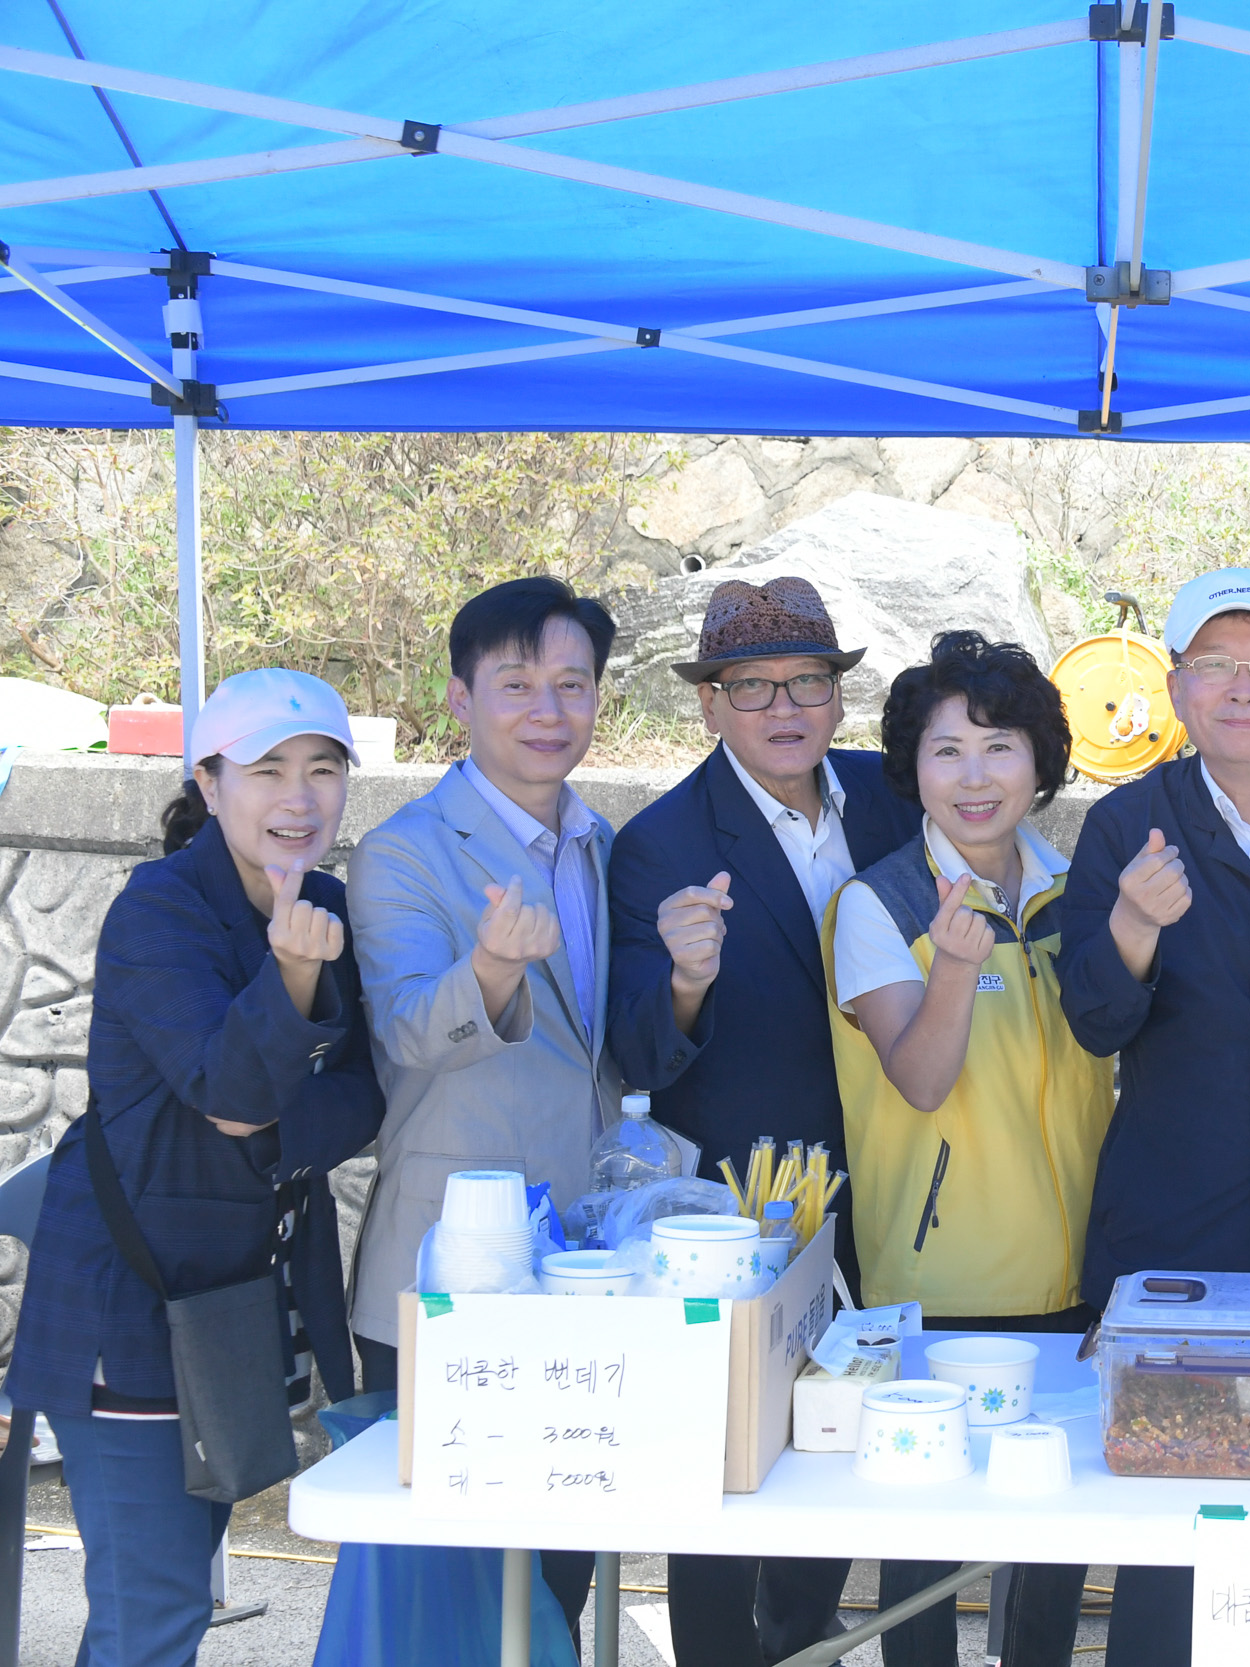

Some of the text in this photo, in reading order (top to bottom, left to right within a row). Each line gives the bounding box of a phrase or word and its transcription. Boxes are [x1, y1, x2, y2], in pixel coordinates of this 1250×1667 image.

[978, 975, 1002, 985] 진구
[442, 1418, 467, 1447] 소
[542, 1426, 620, 1447] 3000원
[449, 1467, 468, 1496] 대
[547, 1466, 617, 1493] 5000원
